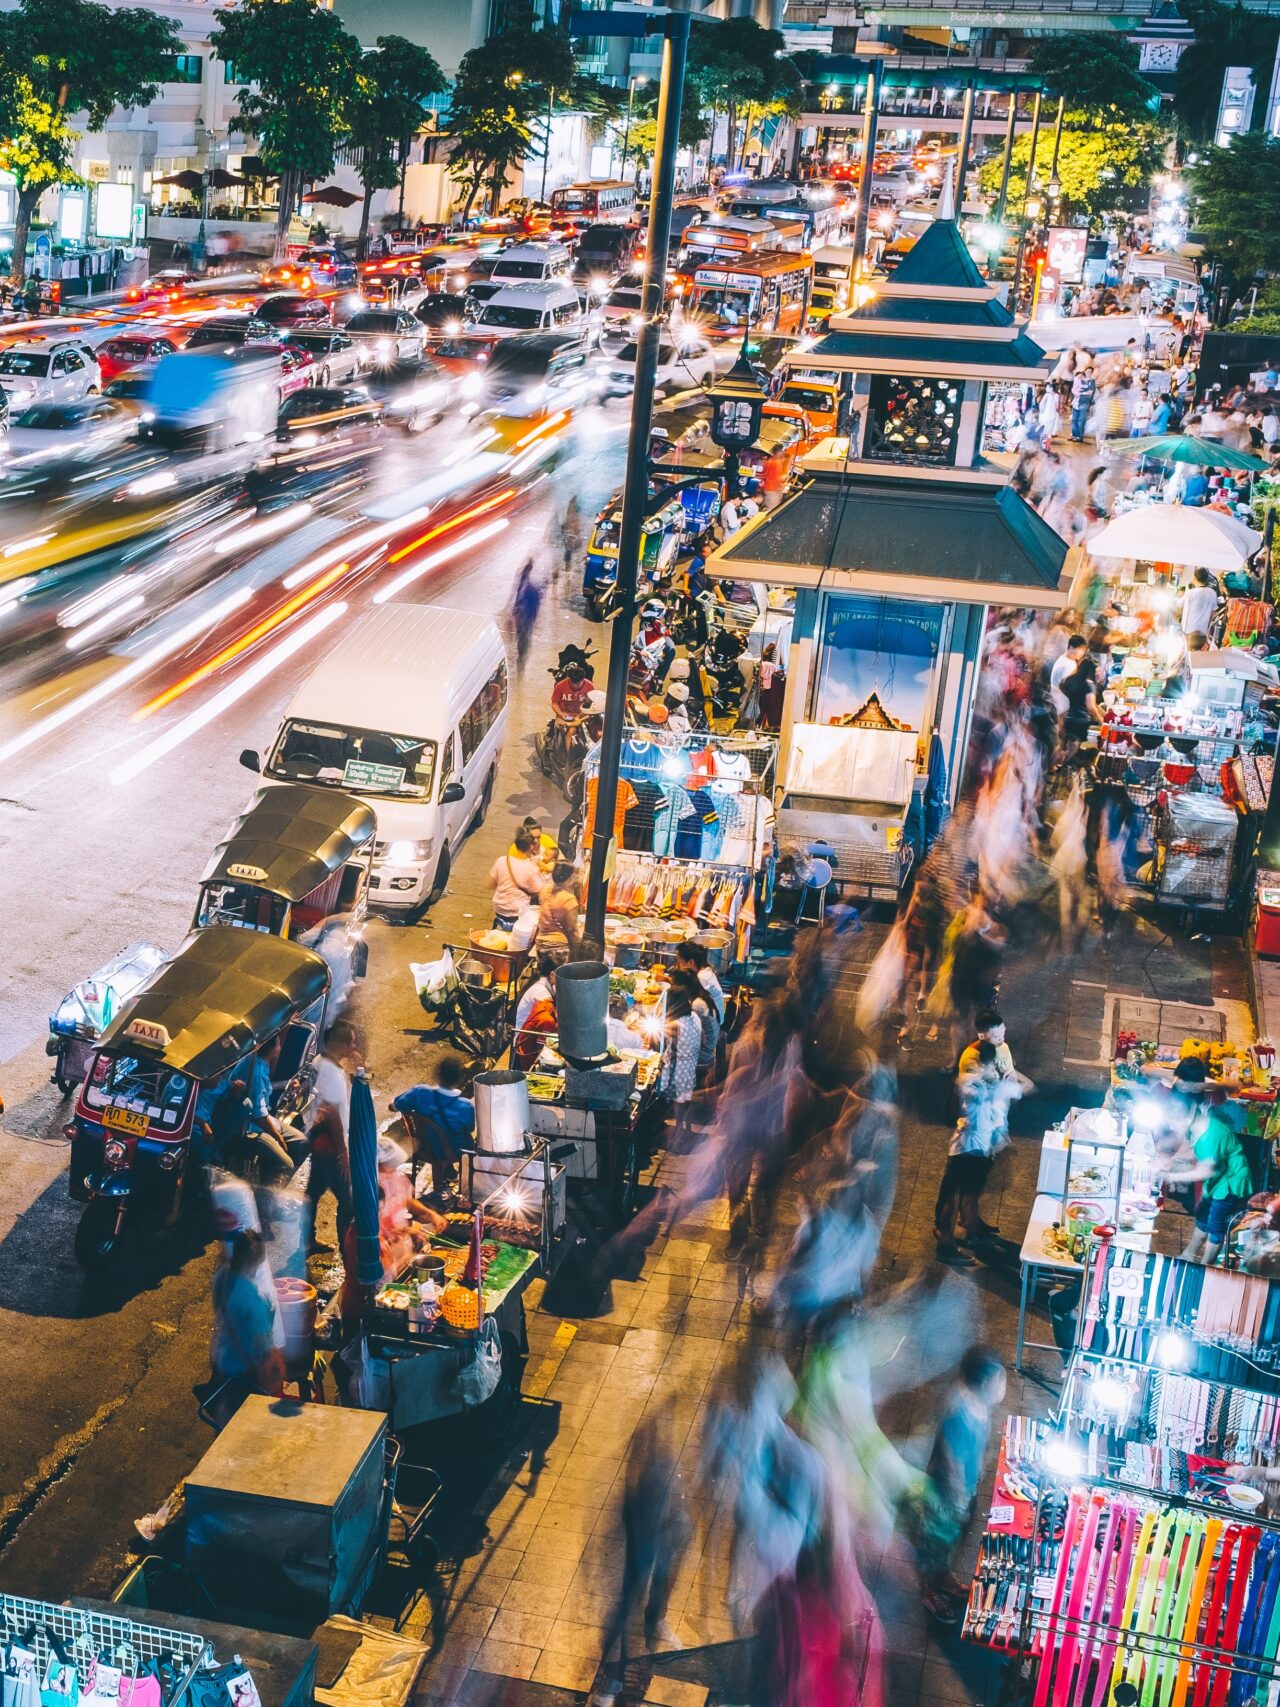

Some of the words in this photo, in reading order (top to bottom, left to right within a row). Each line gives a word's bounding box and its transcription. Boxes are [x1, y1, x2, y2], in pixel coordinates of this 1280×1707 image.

[950, 12, 992, 24] Bangkok
[236, 866, 257, 876] TAXI
[133, 1022, 160, 1039] TAXI
[126, 1113, 145, 1127] 573
[1111, 1272, 1139, 1290] 50
